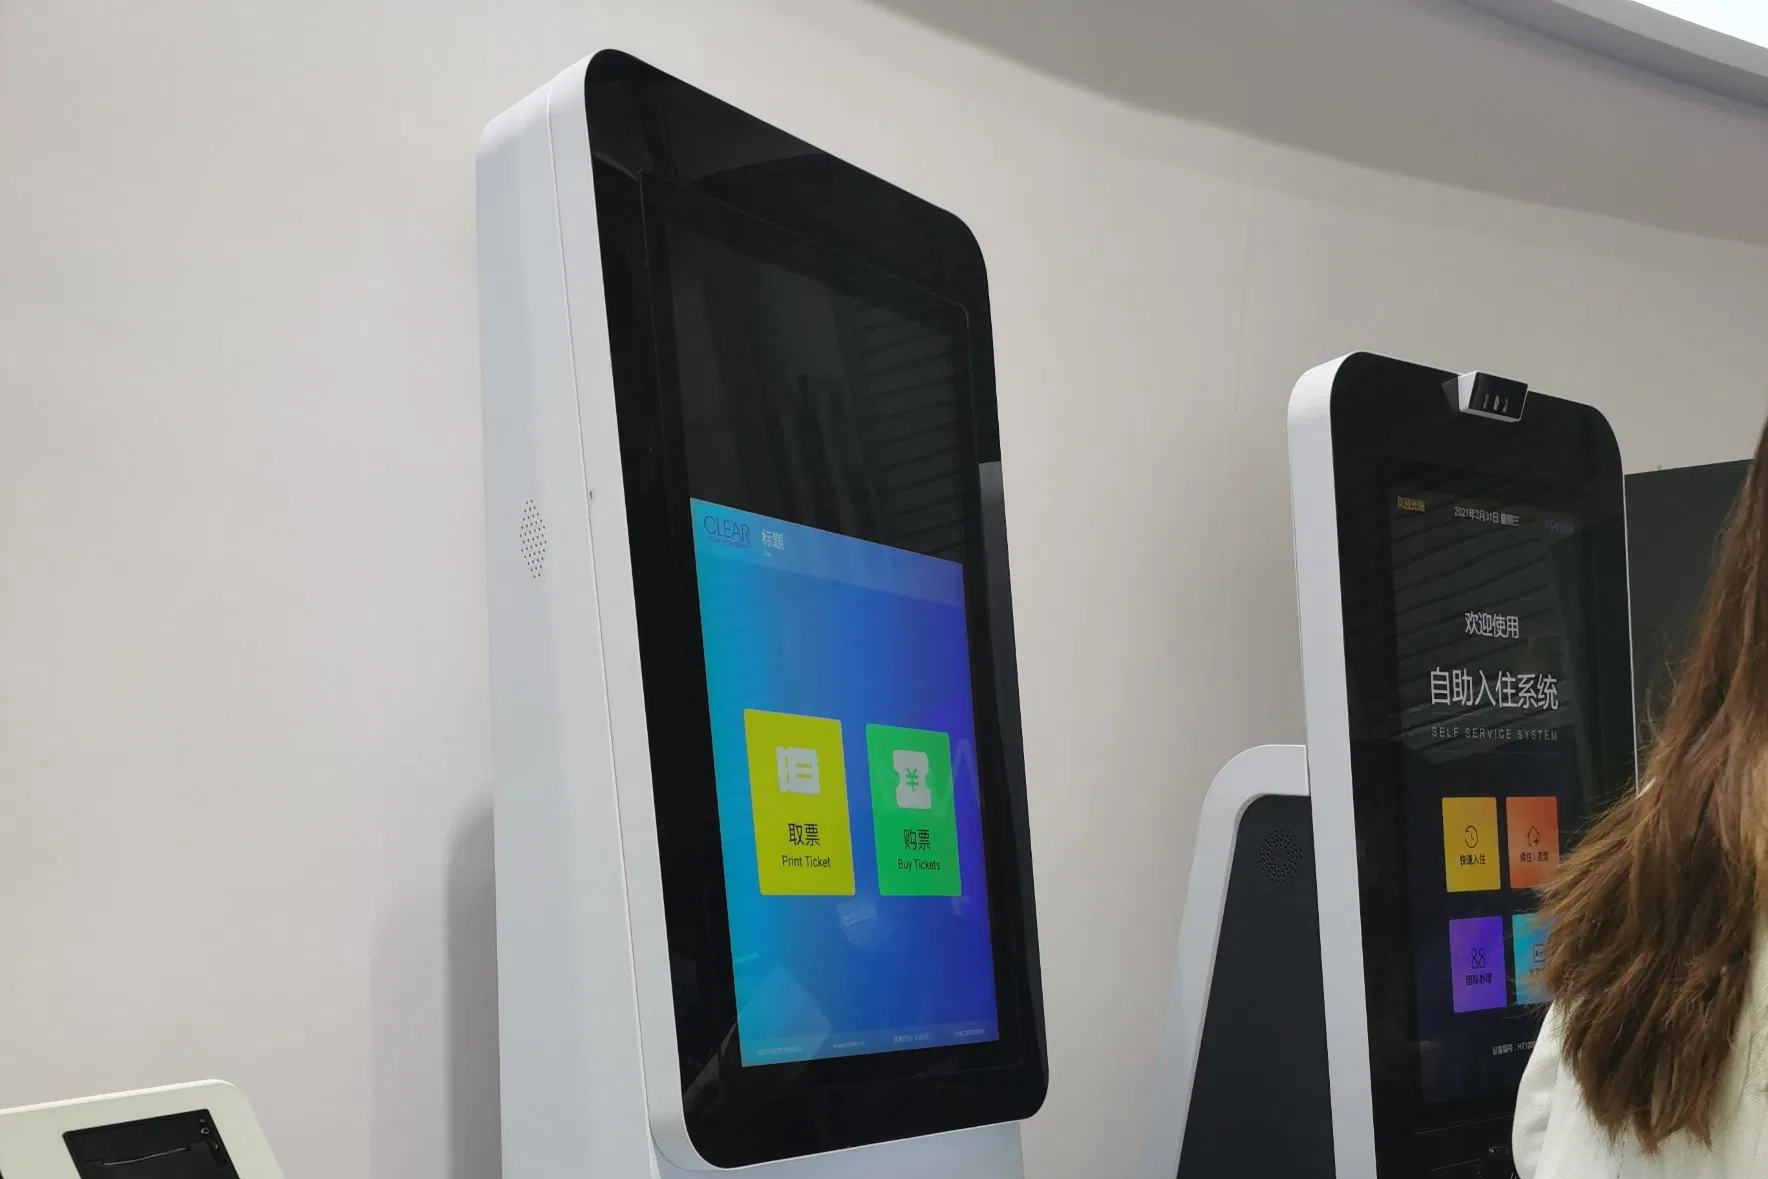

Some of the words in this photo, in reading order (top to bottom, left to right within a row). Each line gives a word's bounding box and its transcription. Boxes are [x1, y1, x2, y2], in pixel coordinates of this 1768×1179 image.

[704, 515, 750, 542] CLEAR
[760, 529, 784, 550] 标题
[1465, 611, 1519, 638] 欢迎使用
[1430, 666, 1558, 710] 自助入住系统
[1431, 727, 1459, 738] SELF
[1465, 727, 1511, 740] SERVICE
[1517, 729, 1557, 741] SYSTEM
[788, 823, 820, 847] 取票
[903, 829, 931, 850] 购票
[782, 855, 802, 868] Print
[807, 856, 831, 868] Ticket
[898, 859, 912, 872] Buy
[915, 859, 940, 871] Tickets
